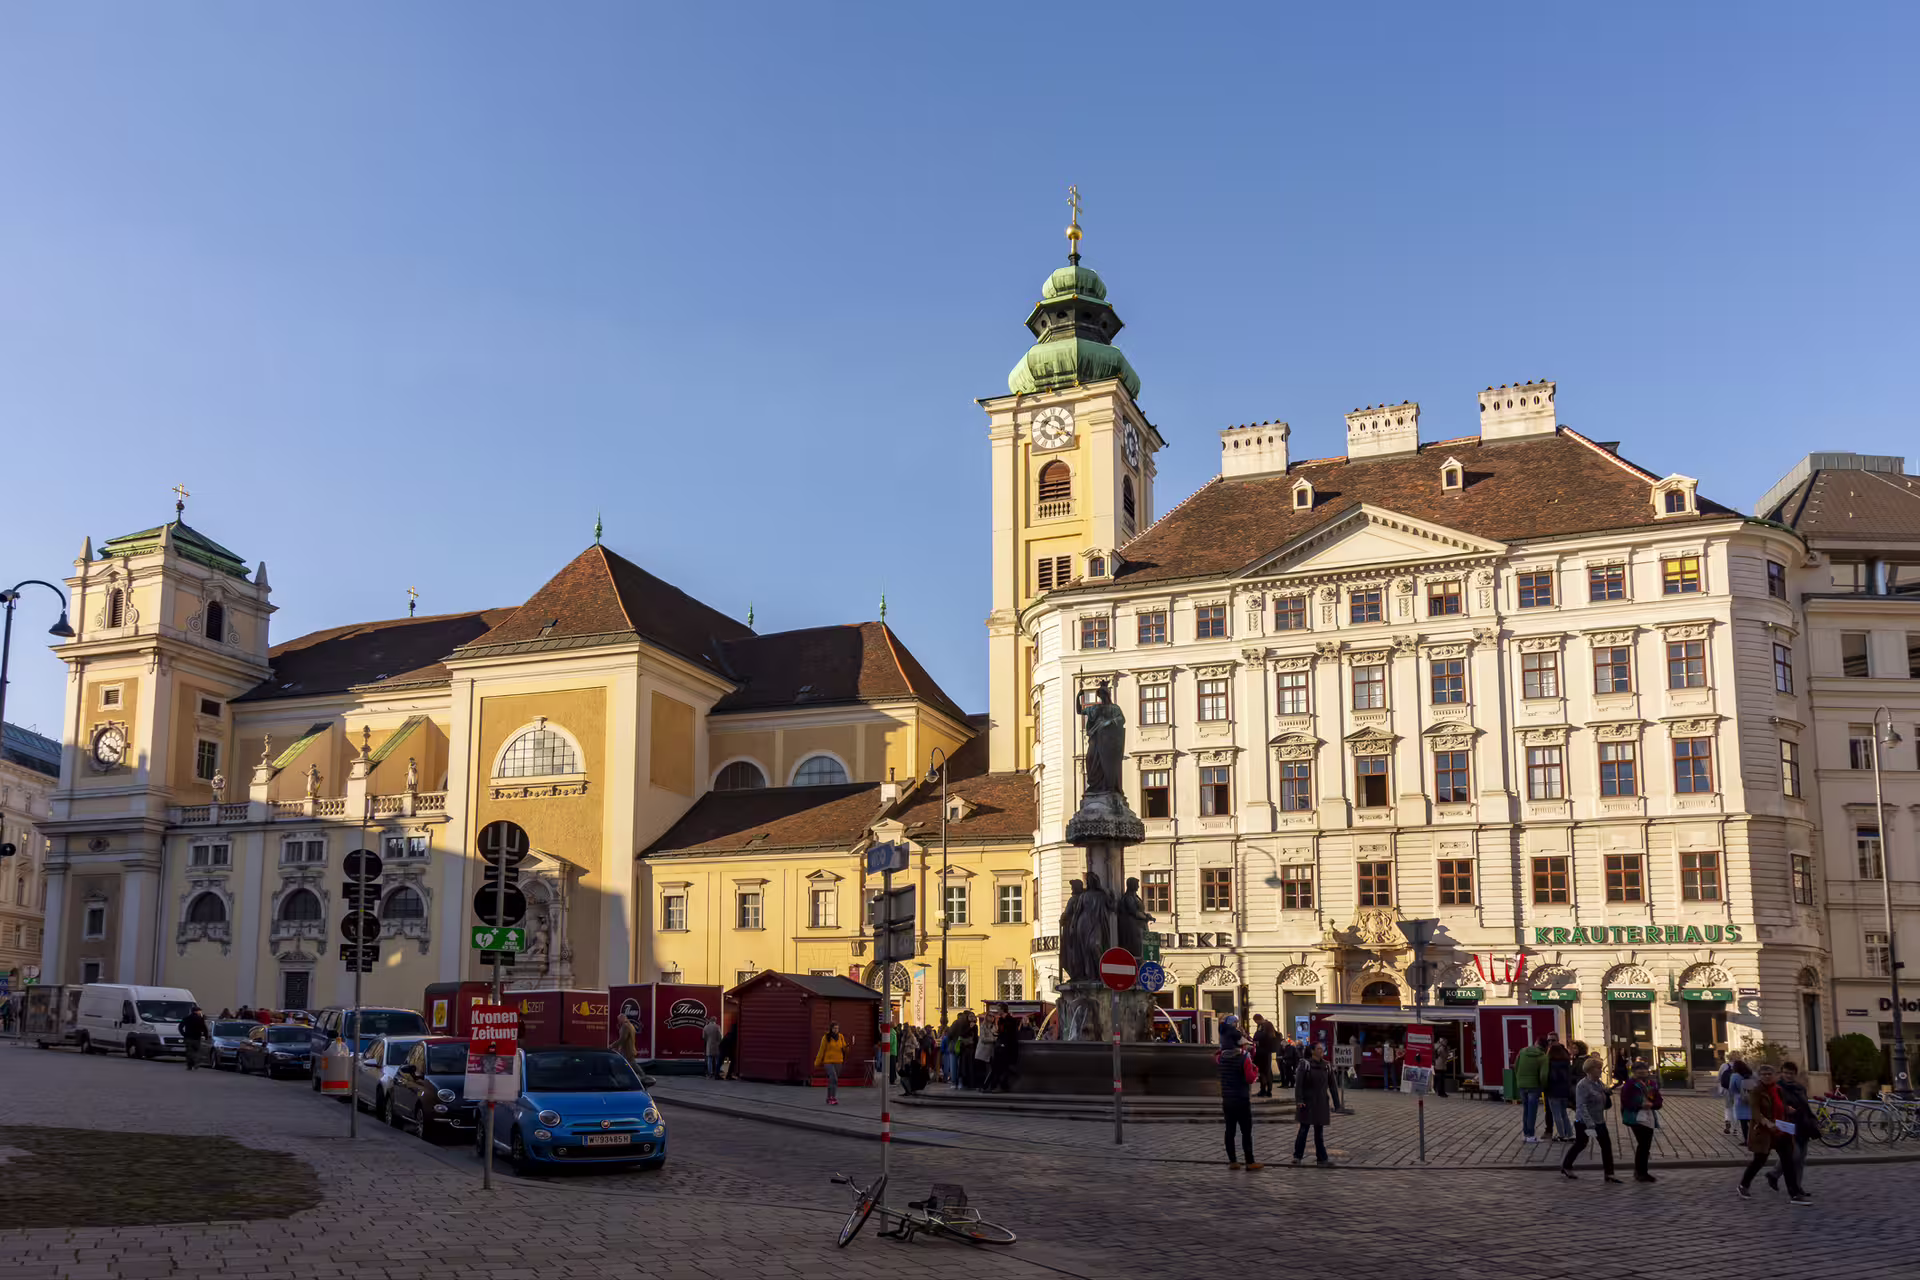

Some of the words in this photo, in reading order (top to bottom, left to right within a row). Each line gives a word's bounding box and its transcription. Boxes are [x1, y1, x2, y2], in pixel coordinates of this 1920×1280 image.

[1160, 932, 1233, 948] HEKE
[1614, 991, 1648, 999] KOTTAS
[673, 1003, 704, 1014] Thum
[1879, 997, 1920, 1012] Dloi
[471, 1010, 518, 1024] Kronen
[471, 1026, 518, 1041] Zeitung
[1335, 1056, 1352, 1064] gebiet
